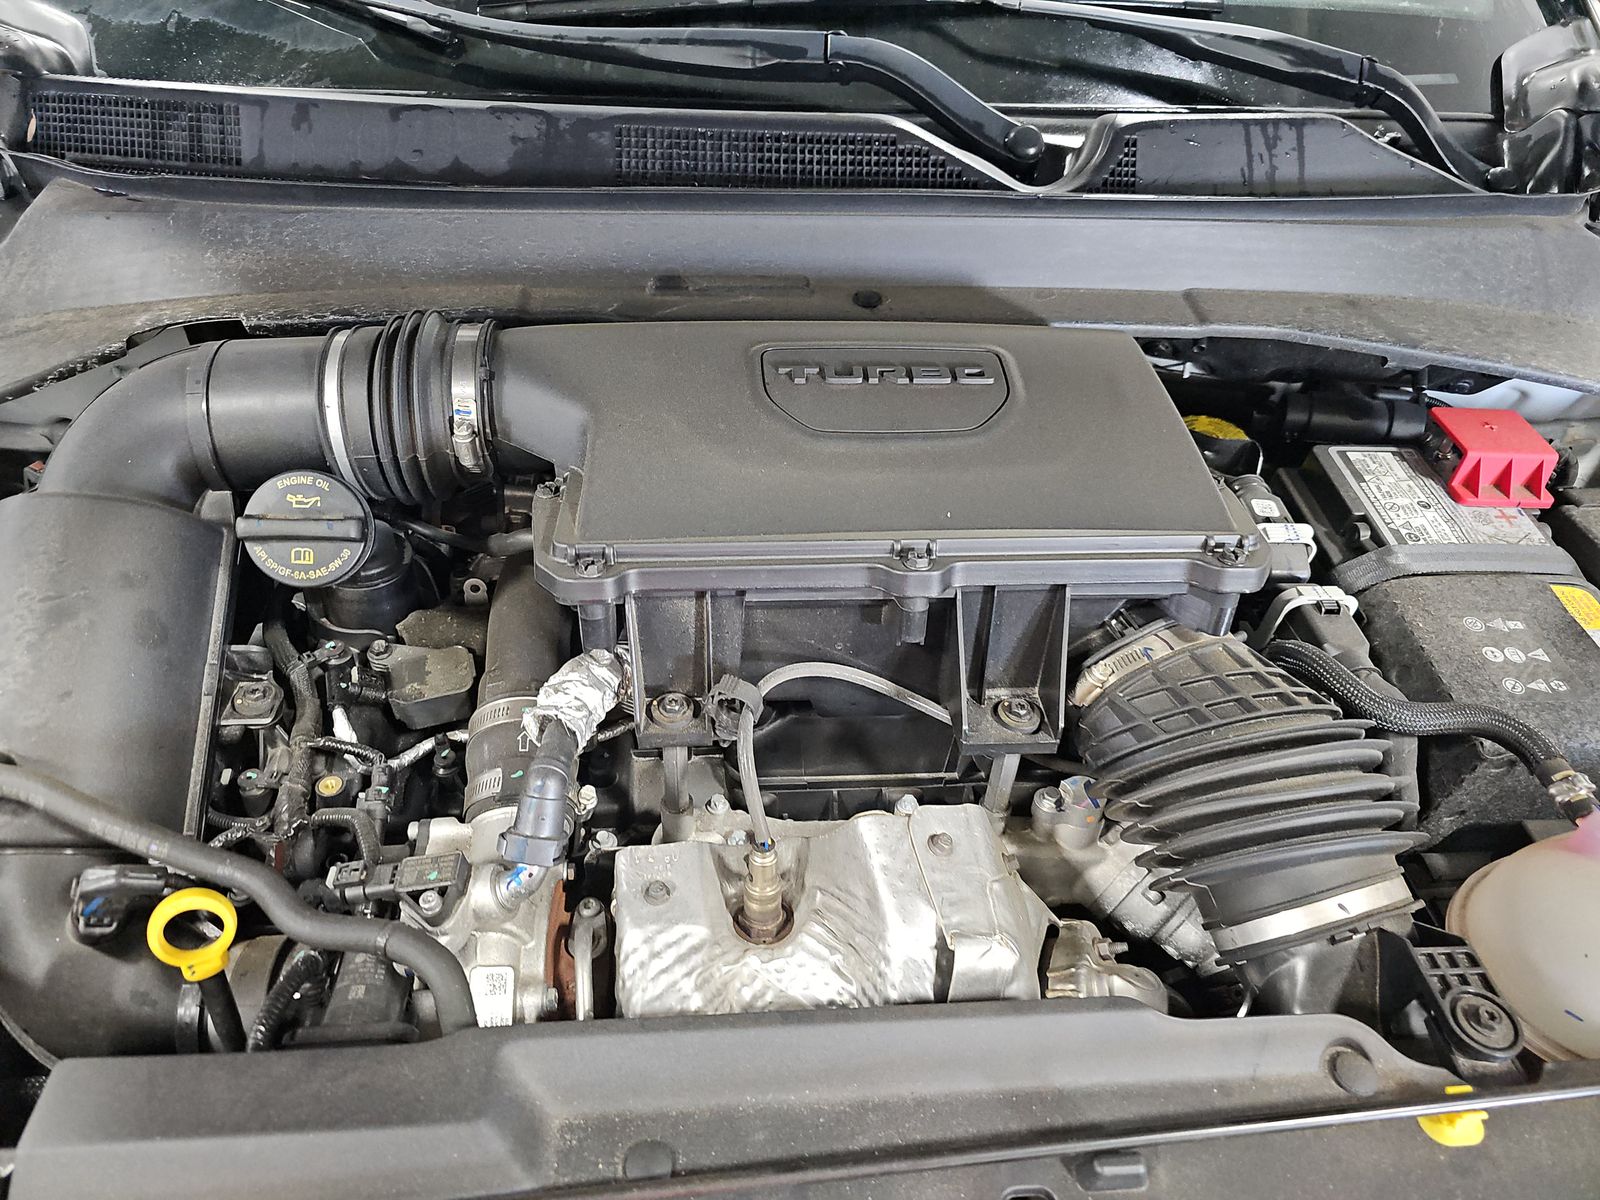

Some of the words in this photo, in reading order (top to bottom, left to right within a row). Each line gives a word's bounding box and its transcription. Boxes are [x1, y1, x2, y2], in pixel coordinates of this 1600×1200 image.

[777, 366, 994, 385] TURBO
[277, 476, 314, 489] ENGINE
[316, 479, 331, 491] OIL
[255, 545, 267, 561] API
